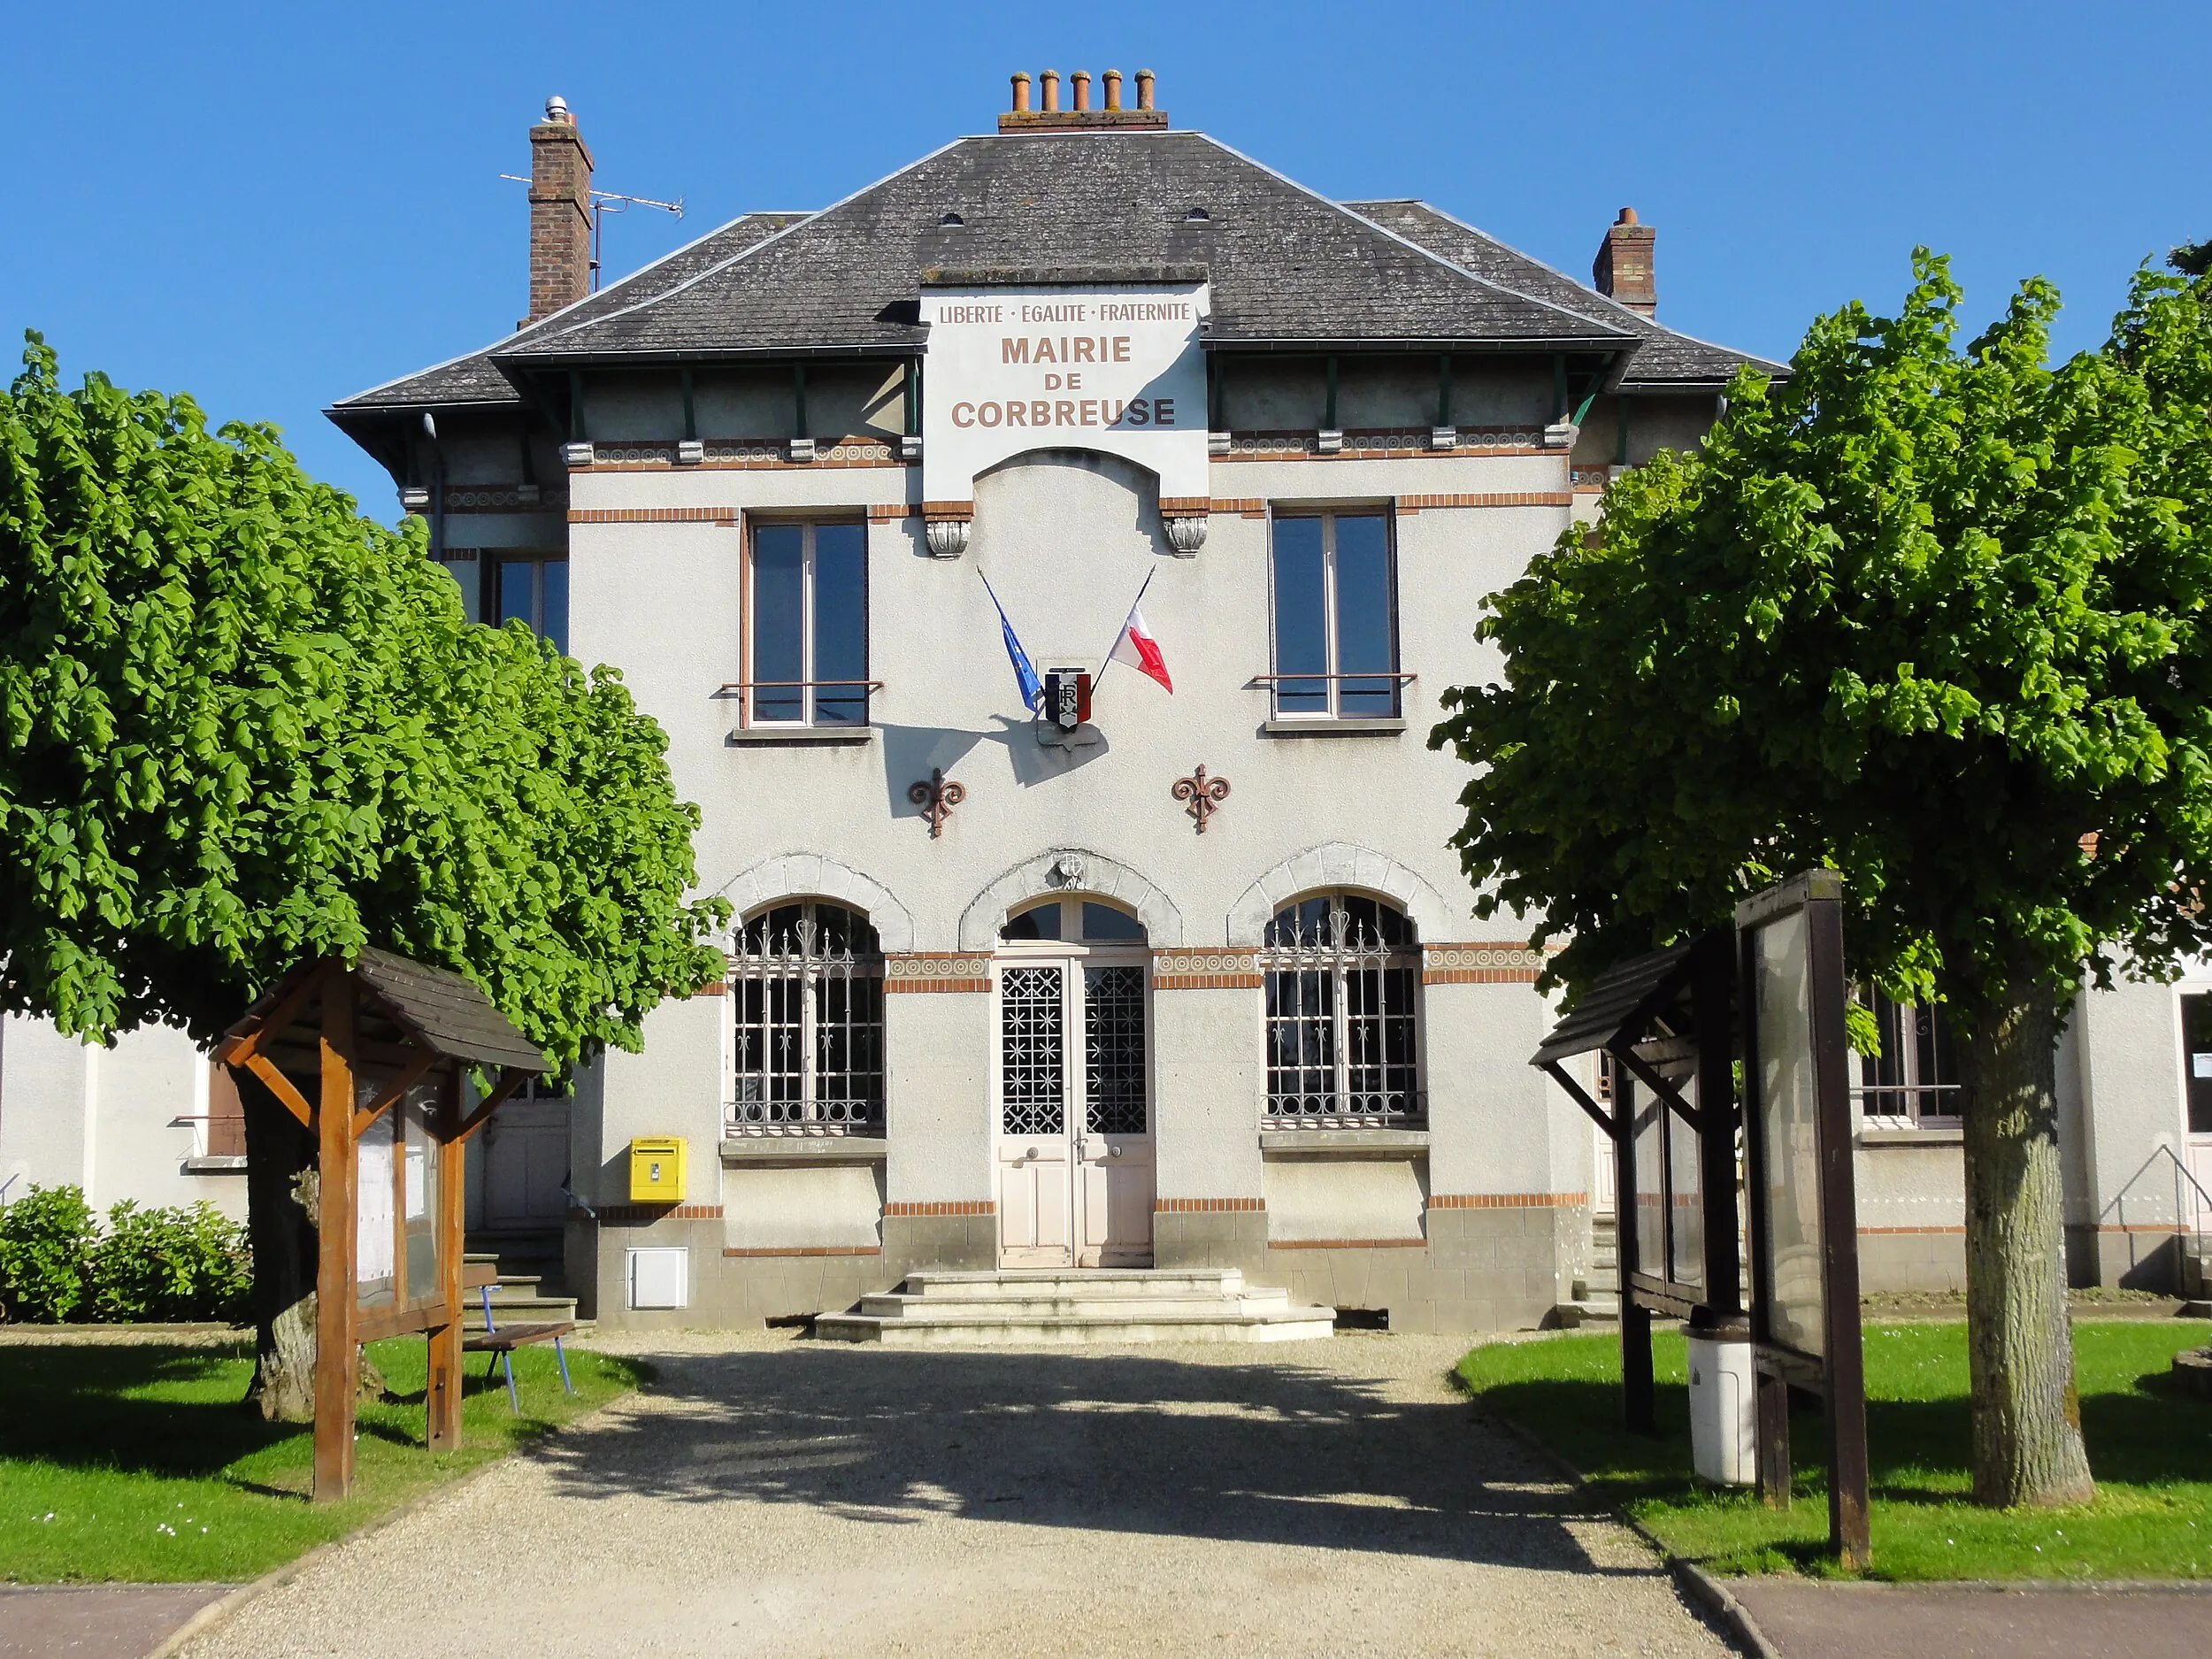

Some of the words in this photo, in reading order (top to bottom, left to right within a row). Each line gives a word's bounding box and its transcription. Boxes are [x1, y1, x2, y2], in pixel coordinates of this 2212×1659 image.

[1002, 336, 1131, 364] MAIRIE
[1045, 373, 1081, 390] DE
[951, 399, 1175, 428] CORBREUSE
